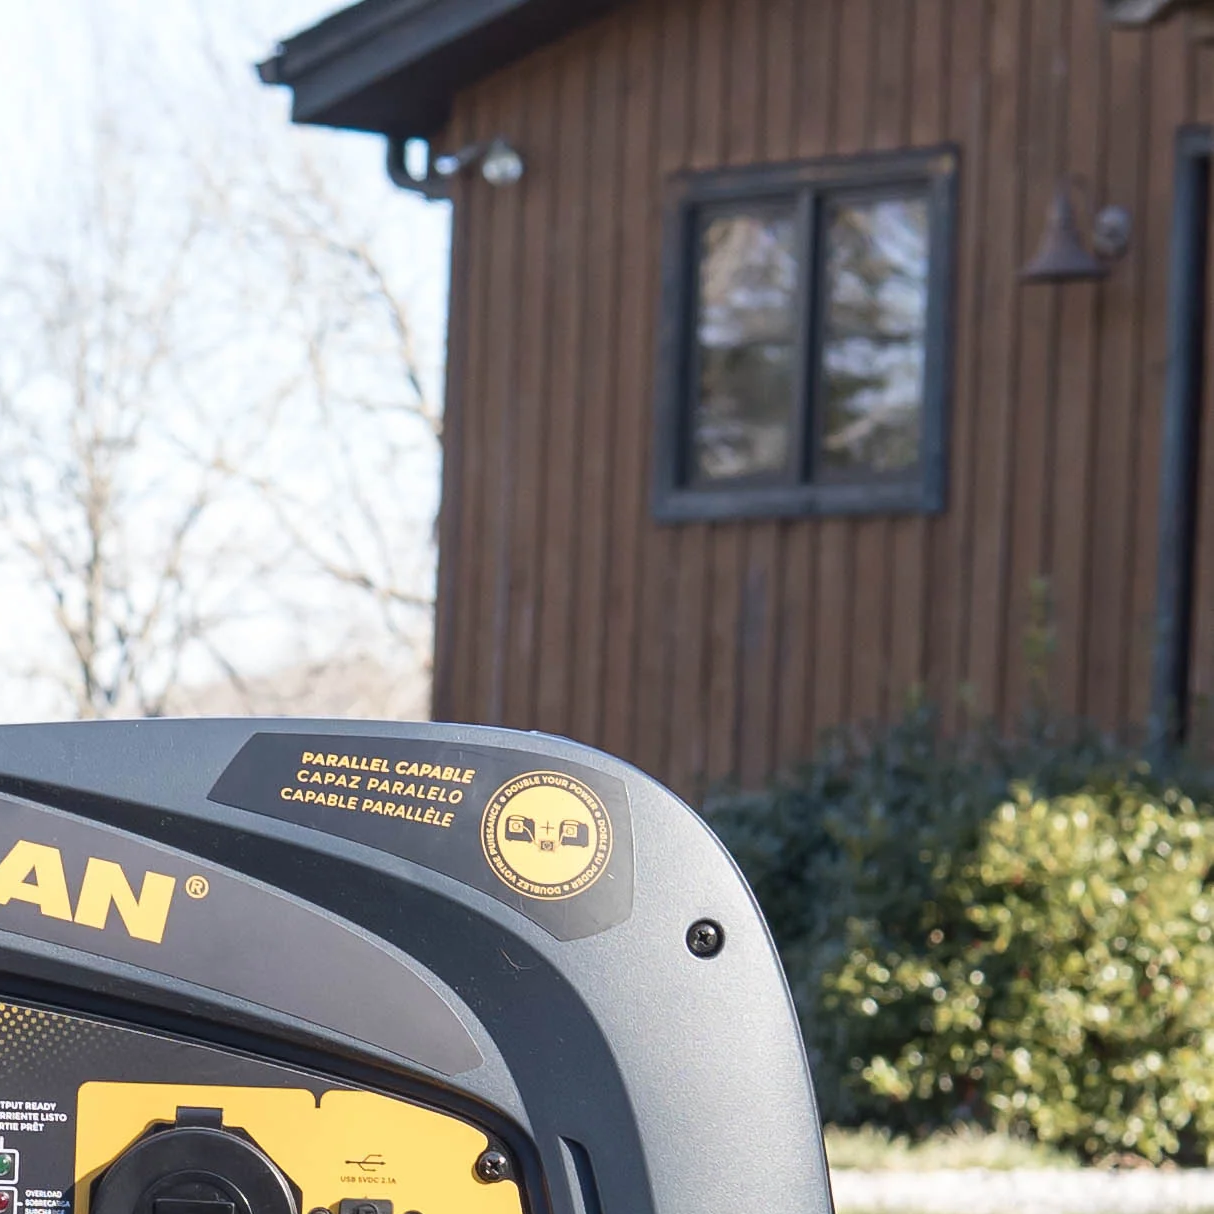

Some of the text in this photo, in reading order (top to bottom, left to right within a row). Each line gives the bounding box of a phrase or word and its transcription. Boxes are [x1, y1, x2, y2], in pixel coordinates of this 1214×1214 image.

[302, 751, 476, 785] PARALLEL CAPABLE
[296, 769, 463, 805] CAPAZ PARALELO
[504, 776, 598, 810] DOUBLE YOUR POWER
[280, 787, 454, 828] CAPABLE PARALLÈLE
[486, 802, 502, 856] PUISSANCE
[493, 856, 517, 883] VOTRE
[24, 1102, 56, 1111] READY
[40, 1112, 68, 1122] LISTO
[20, 1121, 45, 1132] PRÊT
[340, 1175, 357, 1183] USB
[357, 1175, 380, 1184] 5VDC
[24, 1189, 63, 1198] OVERLOAD
